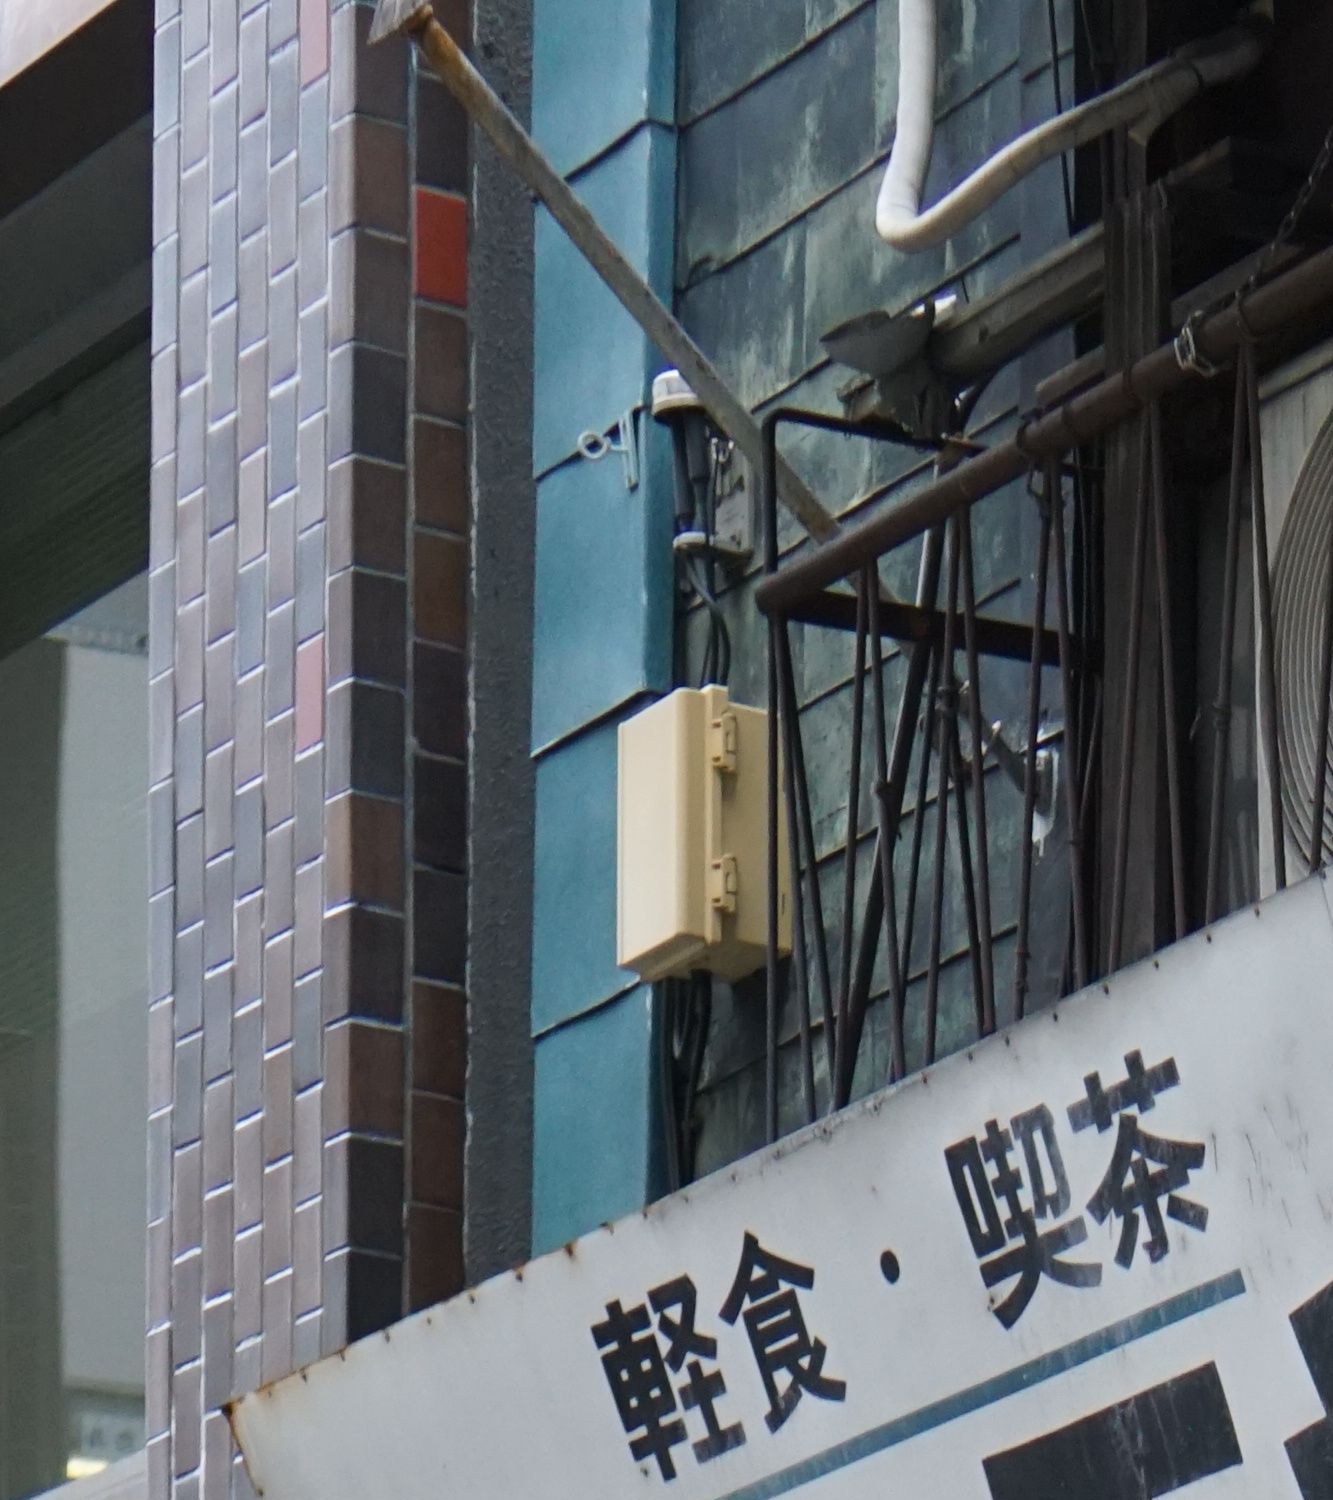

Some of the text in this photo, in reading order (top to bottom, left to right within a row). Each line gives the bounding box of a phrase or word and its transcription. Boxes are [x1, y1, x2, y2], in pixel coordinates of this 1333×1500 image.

[592, 1049, 1208, 1482] 軽食・喫茶
